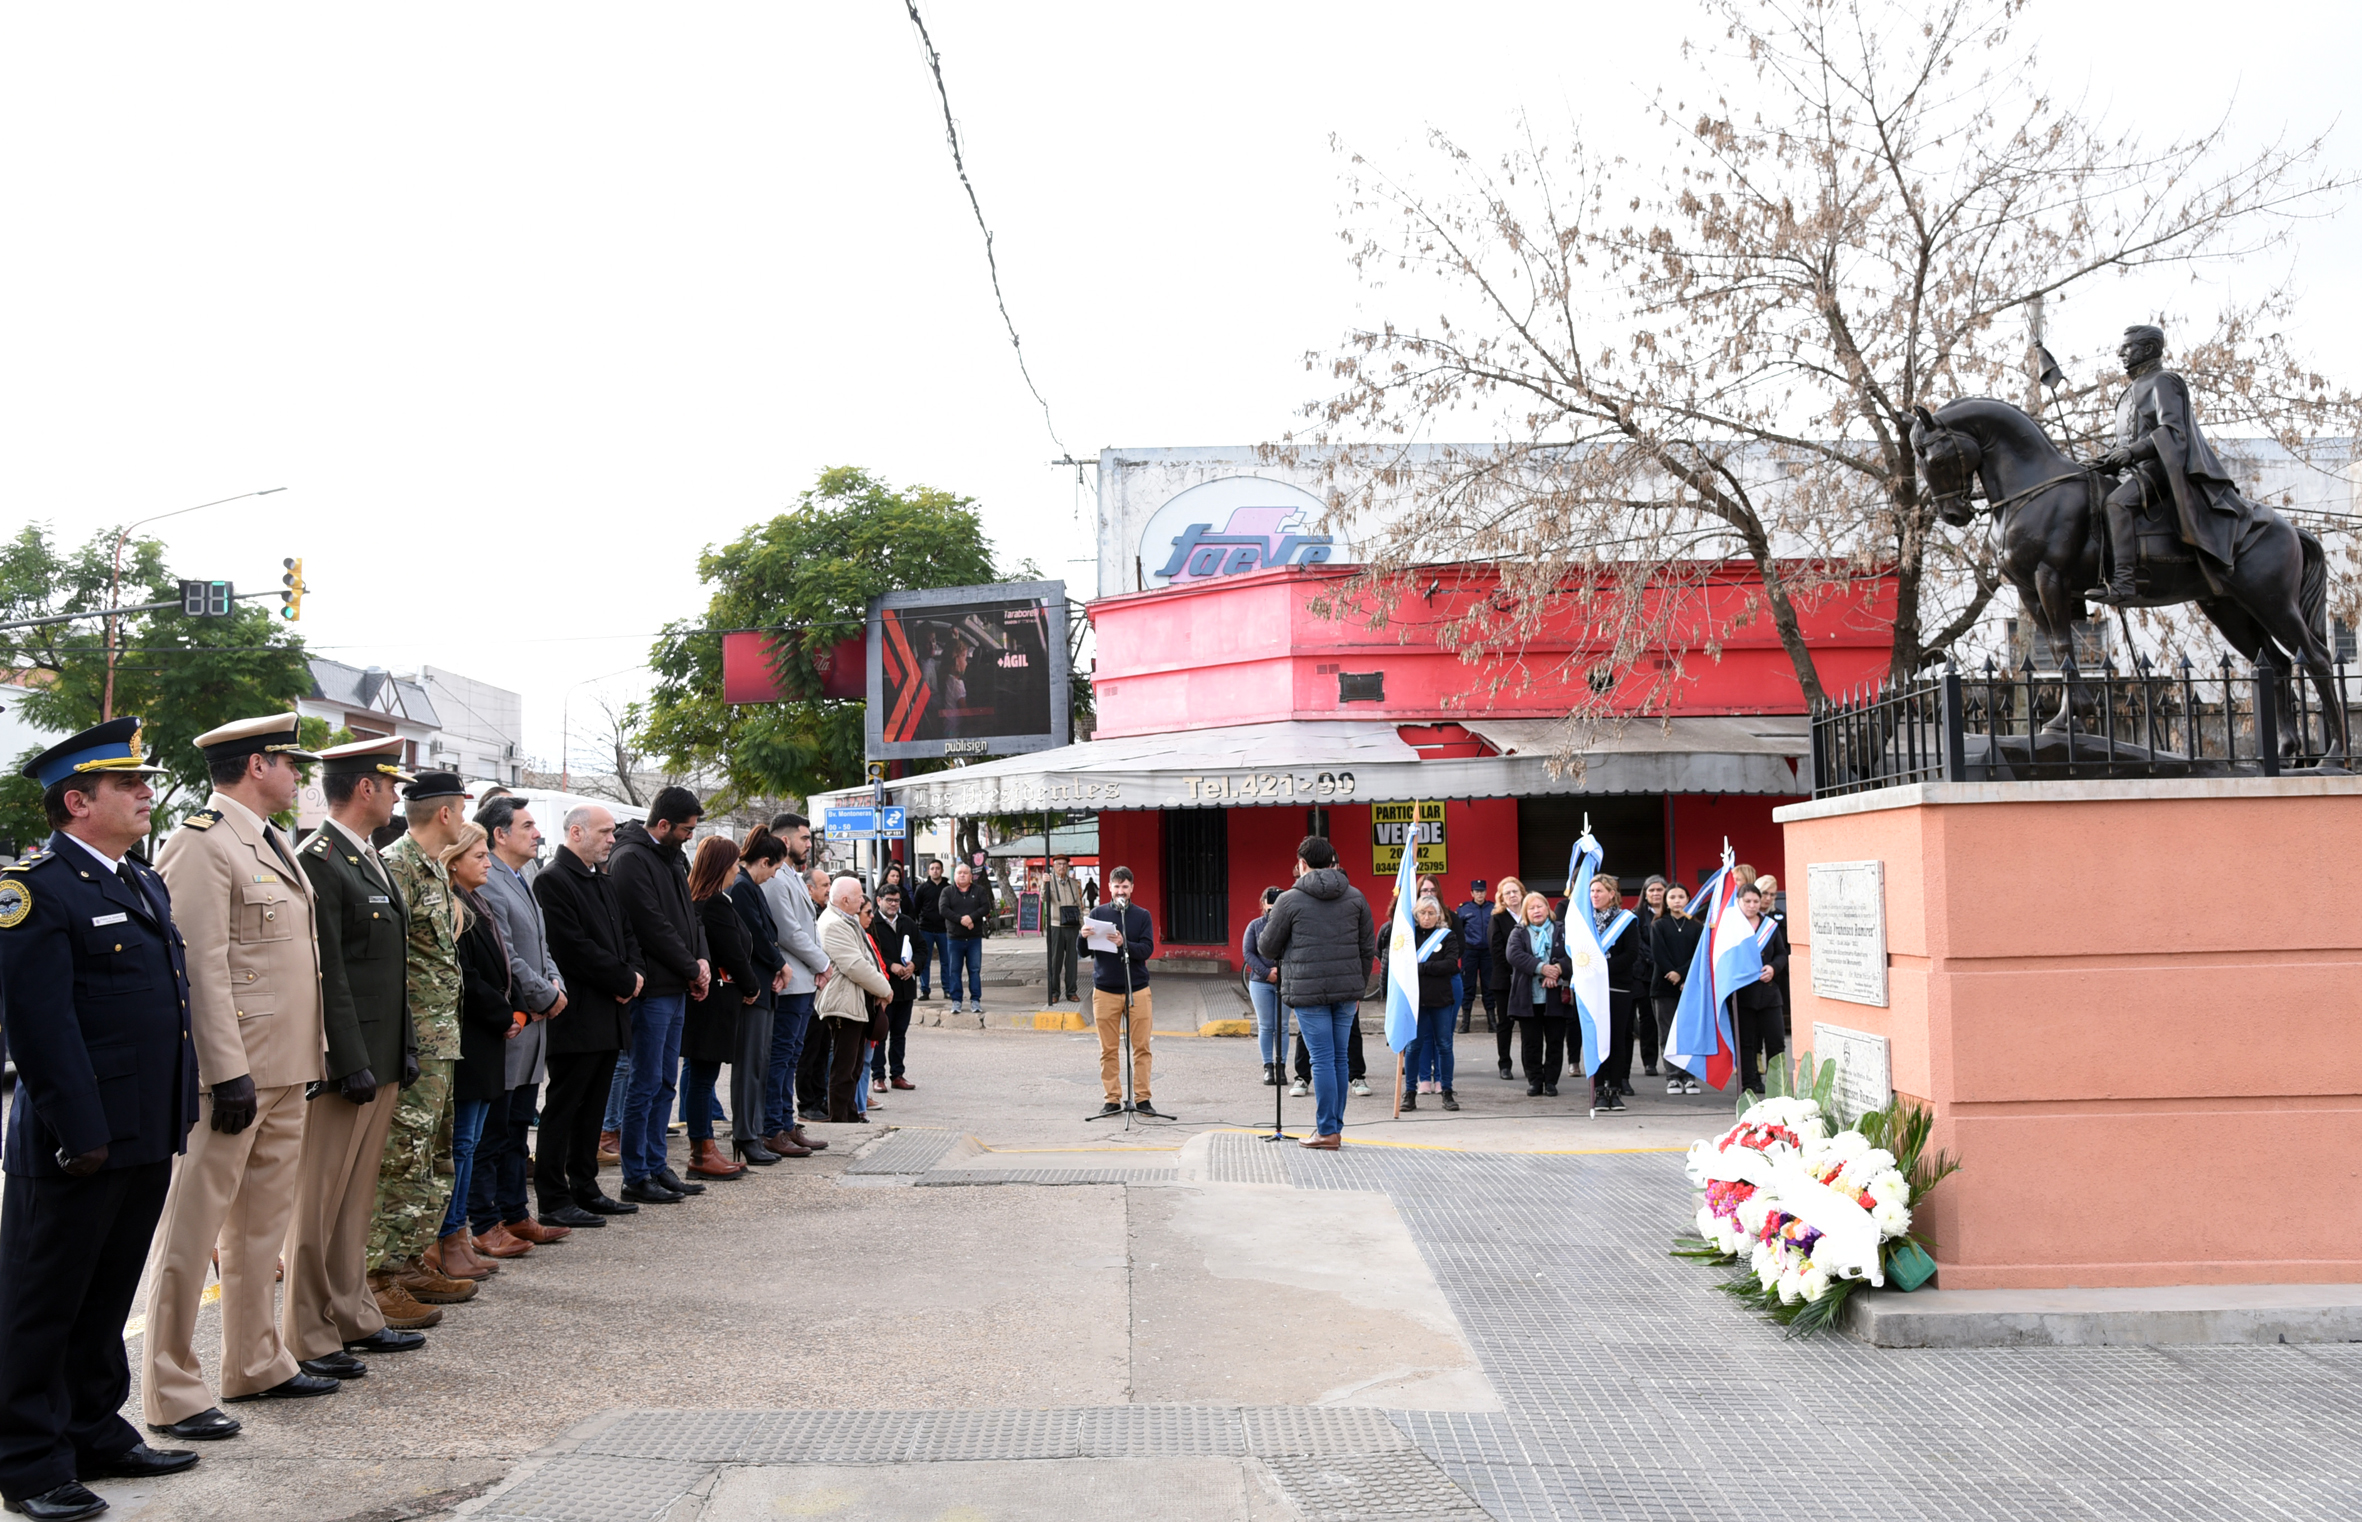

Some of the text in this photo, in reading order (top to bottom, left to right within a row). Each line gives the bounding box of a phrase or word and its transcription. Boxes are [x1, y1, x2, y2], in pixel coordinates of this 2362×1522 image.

[944, 739, 988, 755] publisign
[914, 776, 1121, 815] Los Presidentes
[838, 810, 872, 818] Montoneras
[1376, 805, 1440, 820] PARTICLAR
